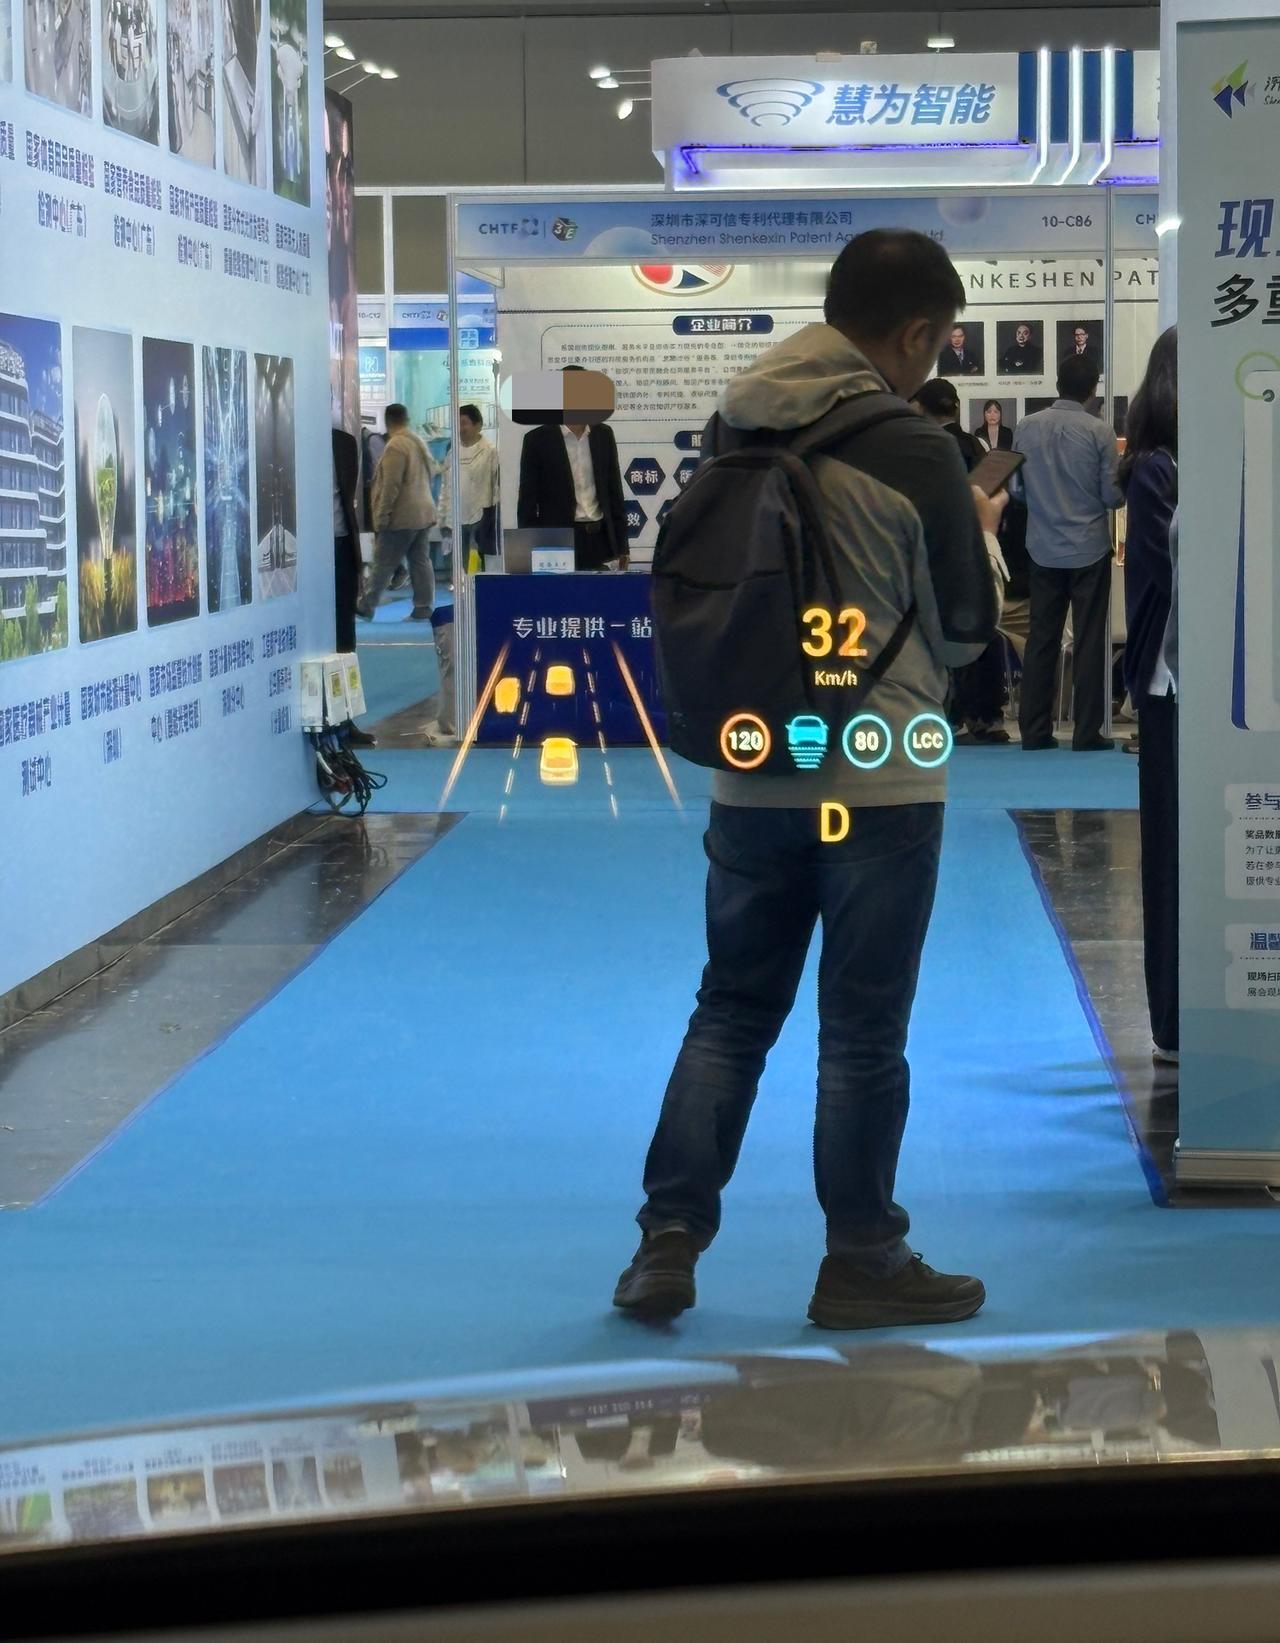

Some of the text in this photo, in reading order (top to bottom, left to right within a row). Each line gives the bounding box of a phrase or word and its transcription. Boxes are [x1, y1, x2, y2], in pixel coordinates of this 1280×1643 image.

[826, 83, 996, 126] 慧为智能
[651, 211, 852, 227] 深圳市深可信专利代理有限公司
[1041, 215, 1092, 228] 10-C86
[478, 223, 519, 235] CHTF
[1215, 199, 1280, 258] 现
[651, 232, 715, 245] Shenzhen
[720, 231, 786, 245] Shenkexin
[790, 231, 831, 244] Patent
[958, 271, 1095, 289] NKESHEN
[690, 318, 753, 332] 企业简介
[630, 470, 658, 484] 商标
[513, 616, 652, 639] 专业提供一站
[801, 607, 868, 657] 32
[814, 670, 858, 687] Km/h
[729, 731, 764, 751] 120
[854, 731, 879, 751] 80
[912, 732, 944, 749] LCC
[820, 802, 850, 842] D
